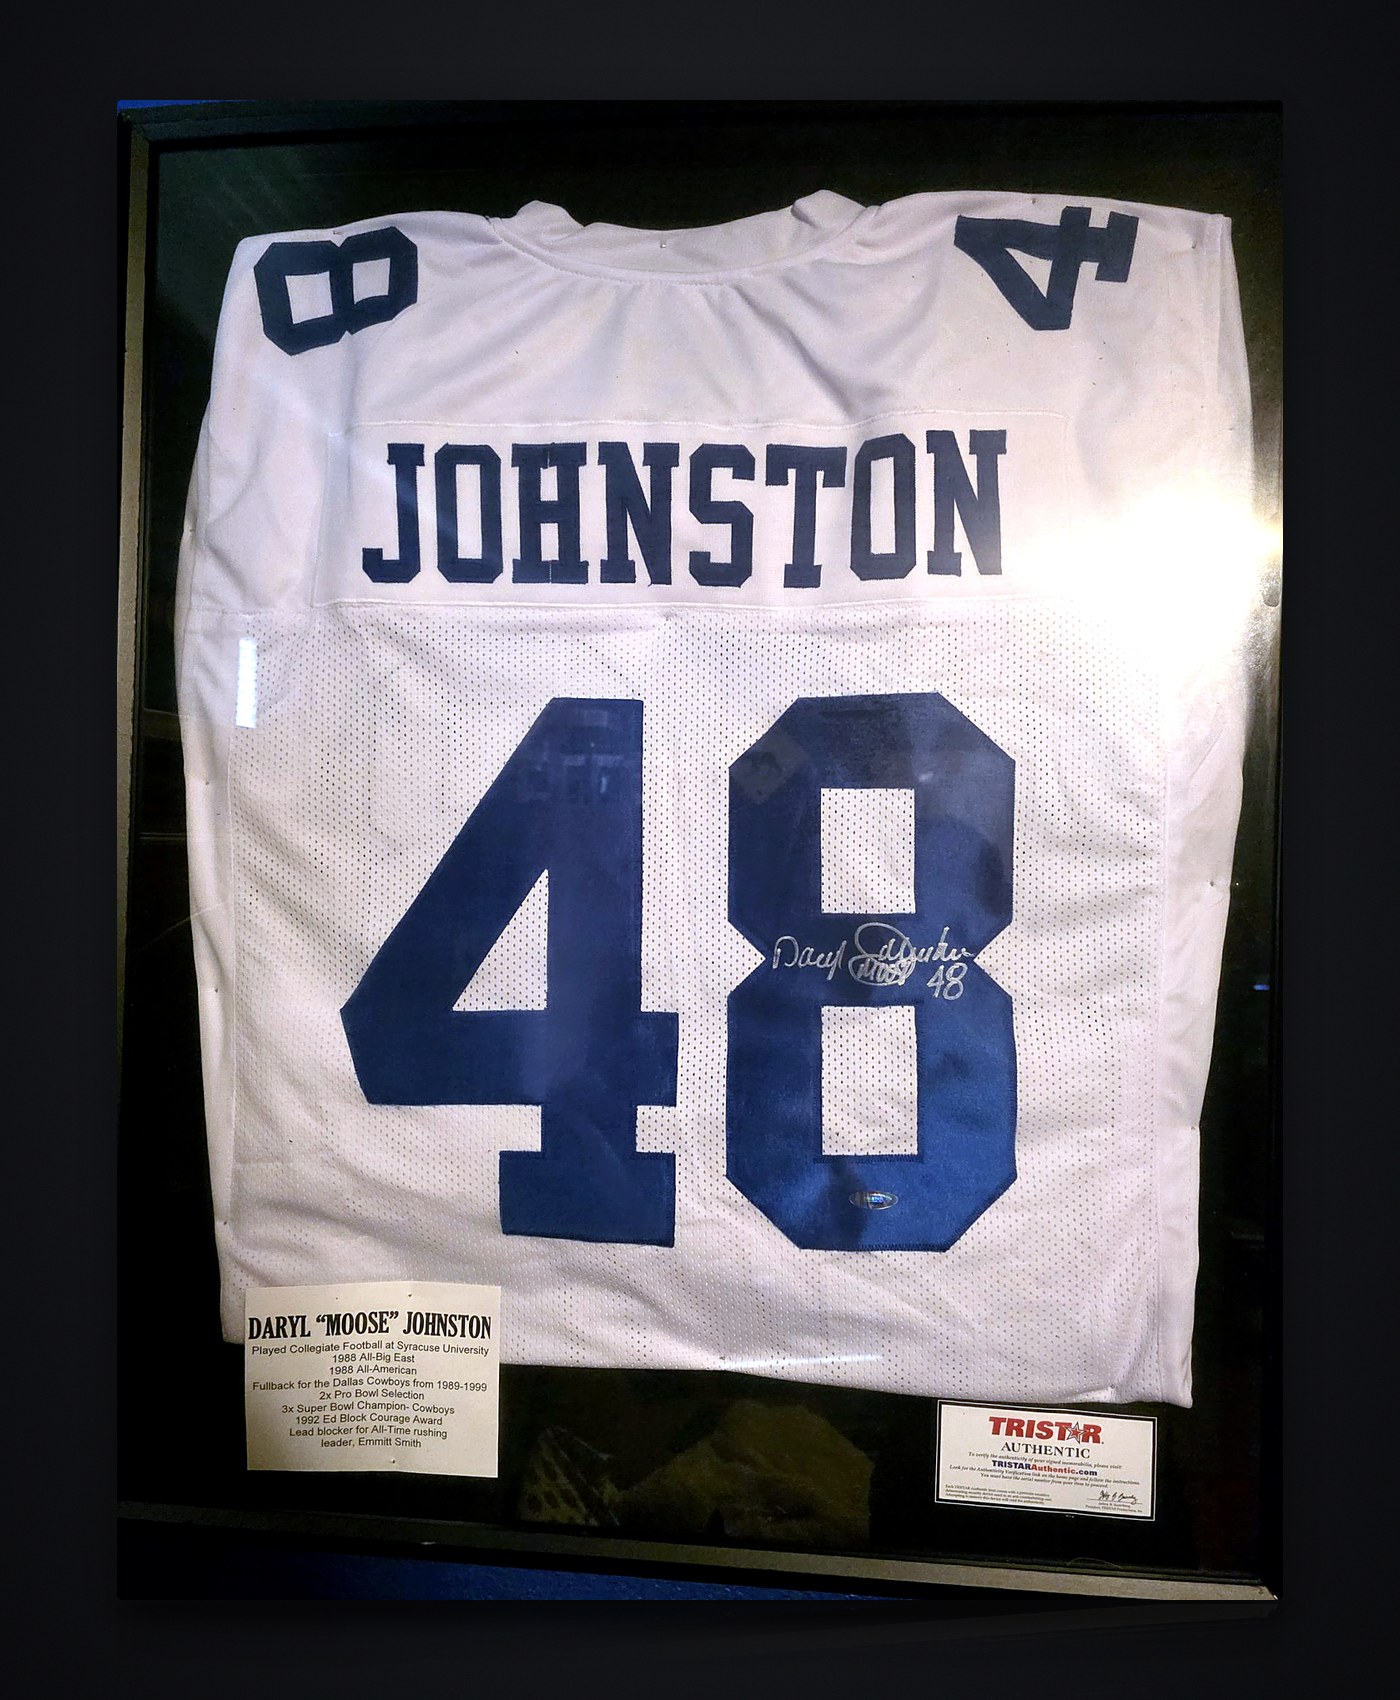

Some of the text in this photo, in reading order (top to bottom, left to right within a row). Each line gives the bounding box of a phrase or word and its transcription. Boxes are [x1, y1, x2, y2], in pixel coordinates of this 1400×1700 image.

[954, 206, 1139, 331] 4
[253, 226, 419, 356] 8
[362, 429, 1007, 588] JOHNSTON
[340, 691, 1018, 1253] 48
[926, 962, 968, 1000] 48
[248, 1315, 311, 1339] DARYL
[403, 1311, 491, 1339] JOHNSTON
[252, 1340, 489, 1357] Played Collegiate Football at Syracuse University
[332, 1352, 415, 1363] 1988 All-Big East
[330, 1364, 417, 1375] 1988 All-American
[252, 1376, 487, 1392] Fullback for the Dallas Cowboys from 1989-1999
[320, 1389, 424, 1400] 2x Pro Bowl Selection
[282, 1405, 294, 1413] 3x
[297, 1404, 327, 1414] Super
[330, 1402, 354, 1411] Bowl
[412, 1403, 454, 1416] Cowboys
[296, 1413, 442, 1425] 1992 Ed Block Courage Award
[289, 1428, 313, 1436] Lead
[318, 1426, 353, 1435] blocker
[371, 1425, 410, 1434] All-Time
[414, 1429, 447, 1440] rushing
[321, 1438, 421, 1448] leader, Emmitt Smith
[1001, 1442, 1090, 1458] AUTHENTIC
